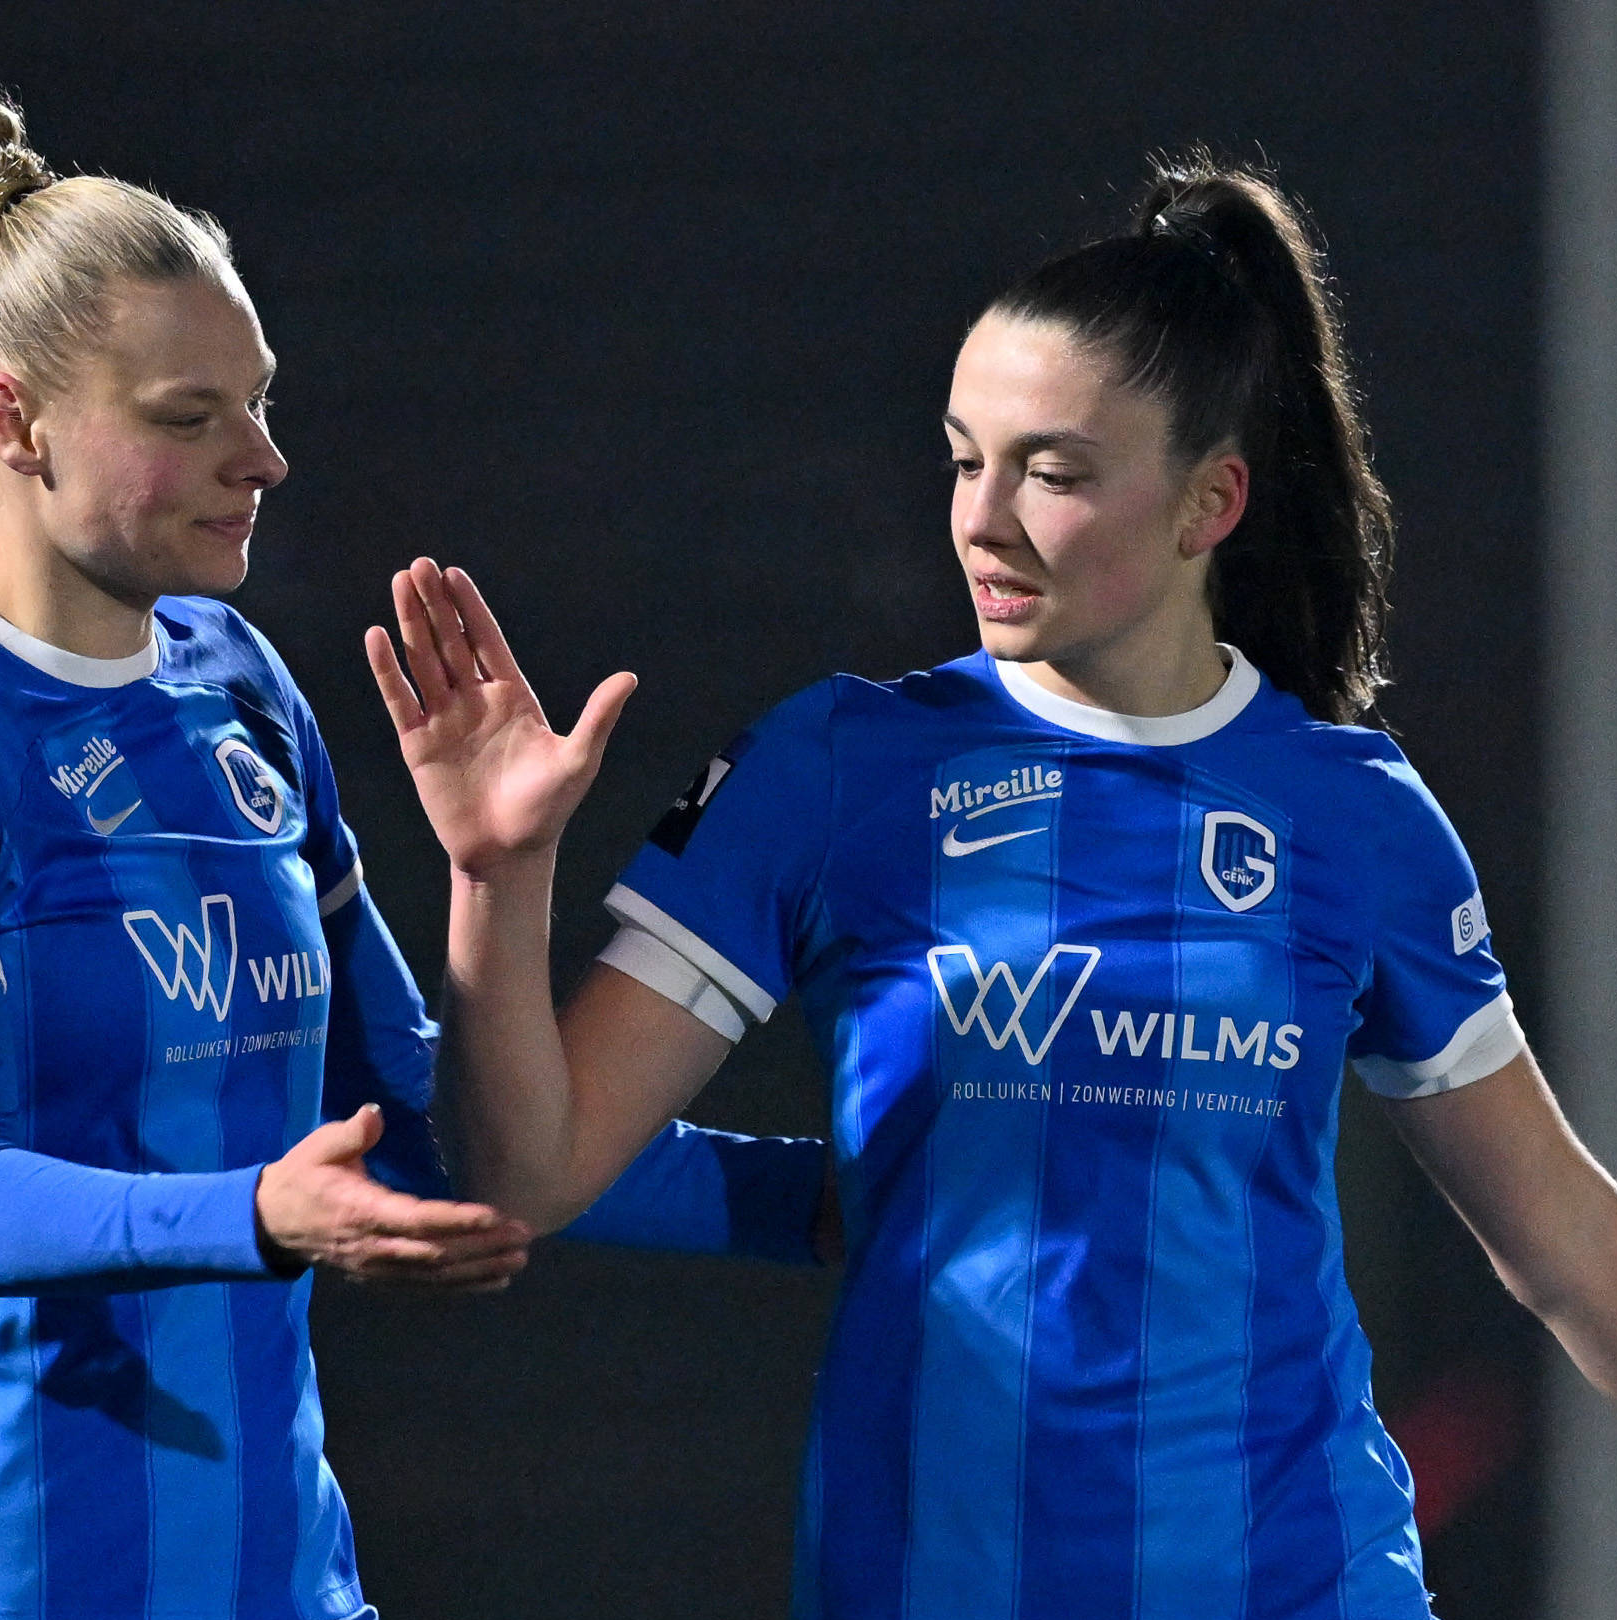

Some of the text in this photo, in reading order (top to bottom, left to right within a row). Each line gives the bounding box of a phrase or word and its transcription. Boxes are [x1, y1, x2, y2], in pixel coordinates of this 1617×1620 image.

[49, 737, 117, 799] Mireille
[929, 765, 1063, 819] Mireille
[1221, 870, 1254, 886] GENK
[165, 1039, 231, 1064] ROLLUIKEN
[241, 1029, 301, 1053] ZONWERING
[1090, 1009, 1304, 1070] WILMS
[953, 1082, 1287, 1117] ROLLUIKEN ZONWERING VENTILATIE
